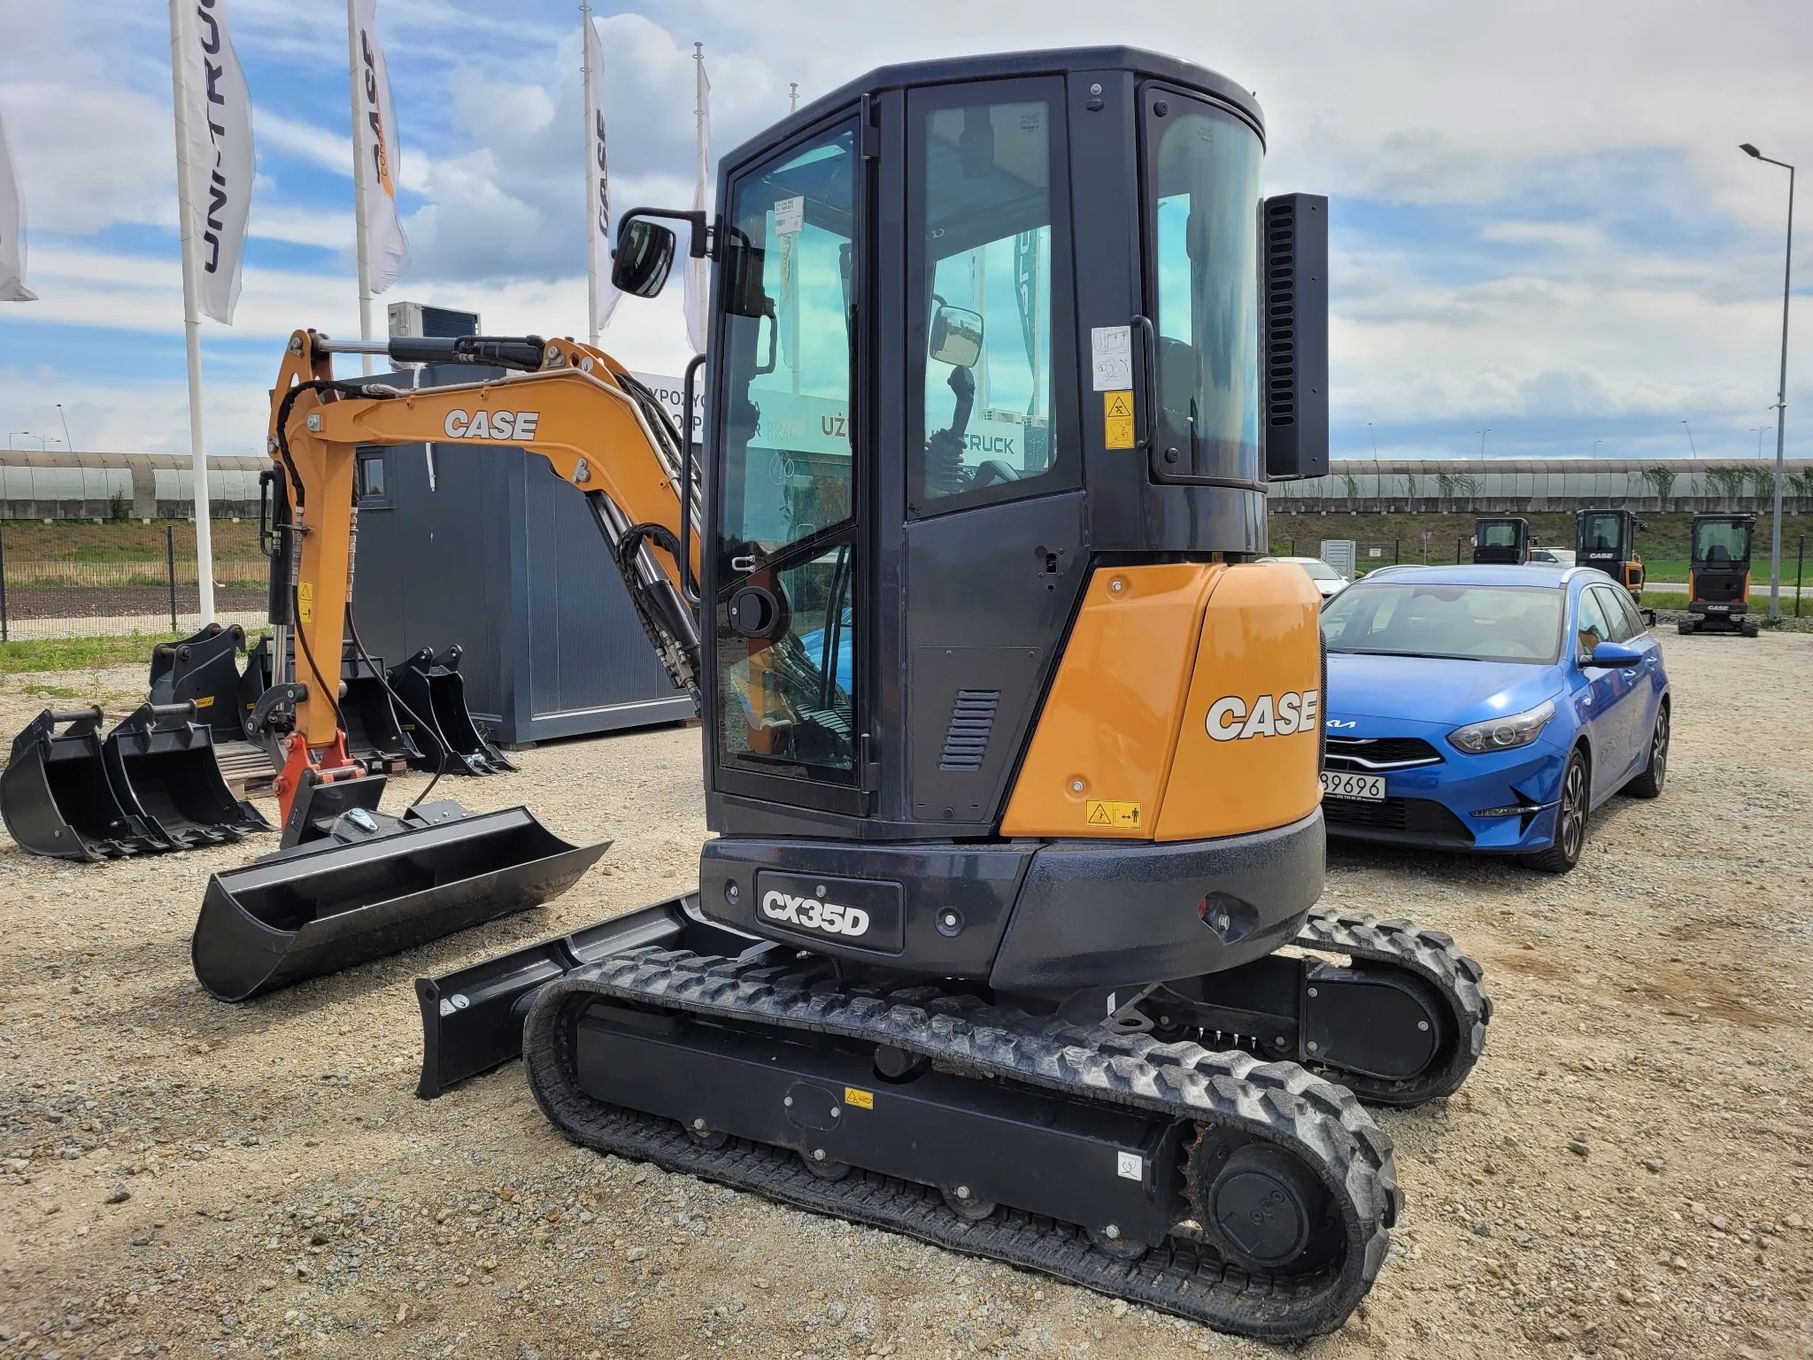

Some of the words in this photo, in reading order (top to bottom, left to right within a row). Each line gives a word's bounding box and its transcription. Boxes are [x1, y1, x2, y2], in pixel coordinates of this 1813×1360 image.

[198, 0, 227, 274] UNI-TRU
[597, 108, 609, 238] CASE
[444, 408, 540, 441] CASE
[1205, 689, 1318, 742] CASE
[762, 890, 870, 937] CX35D
